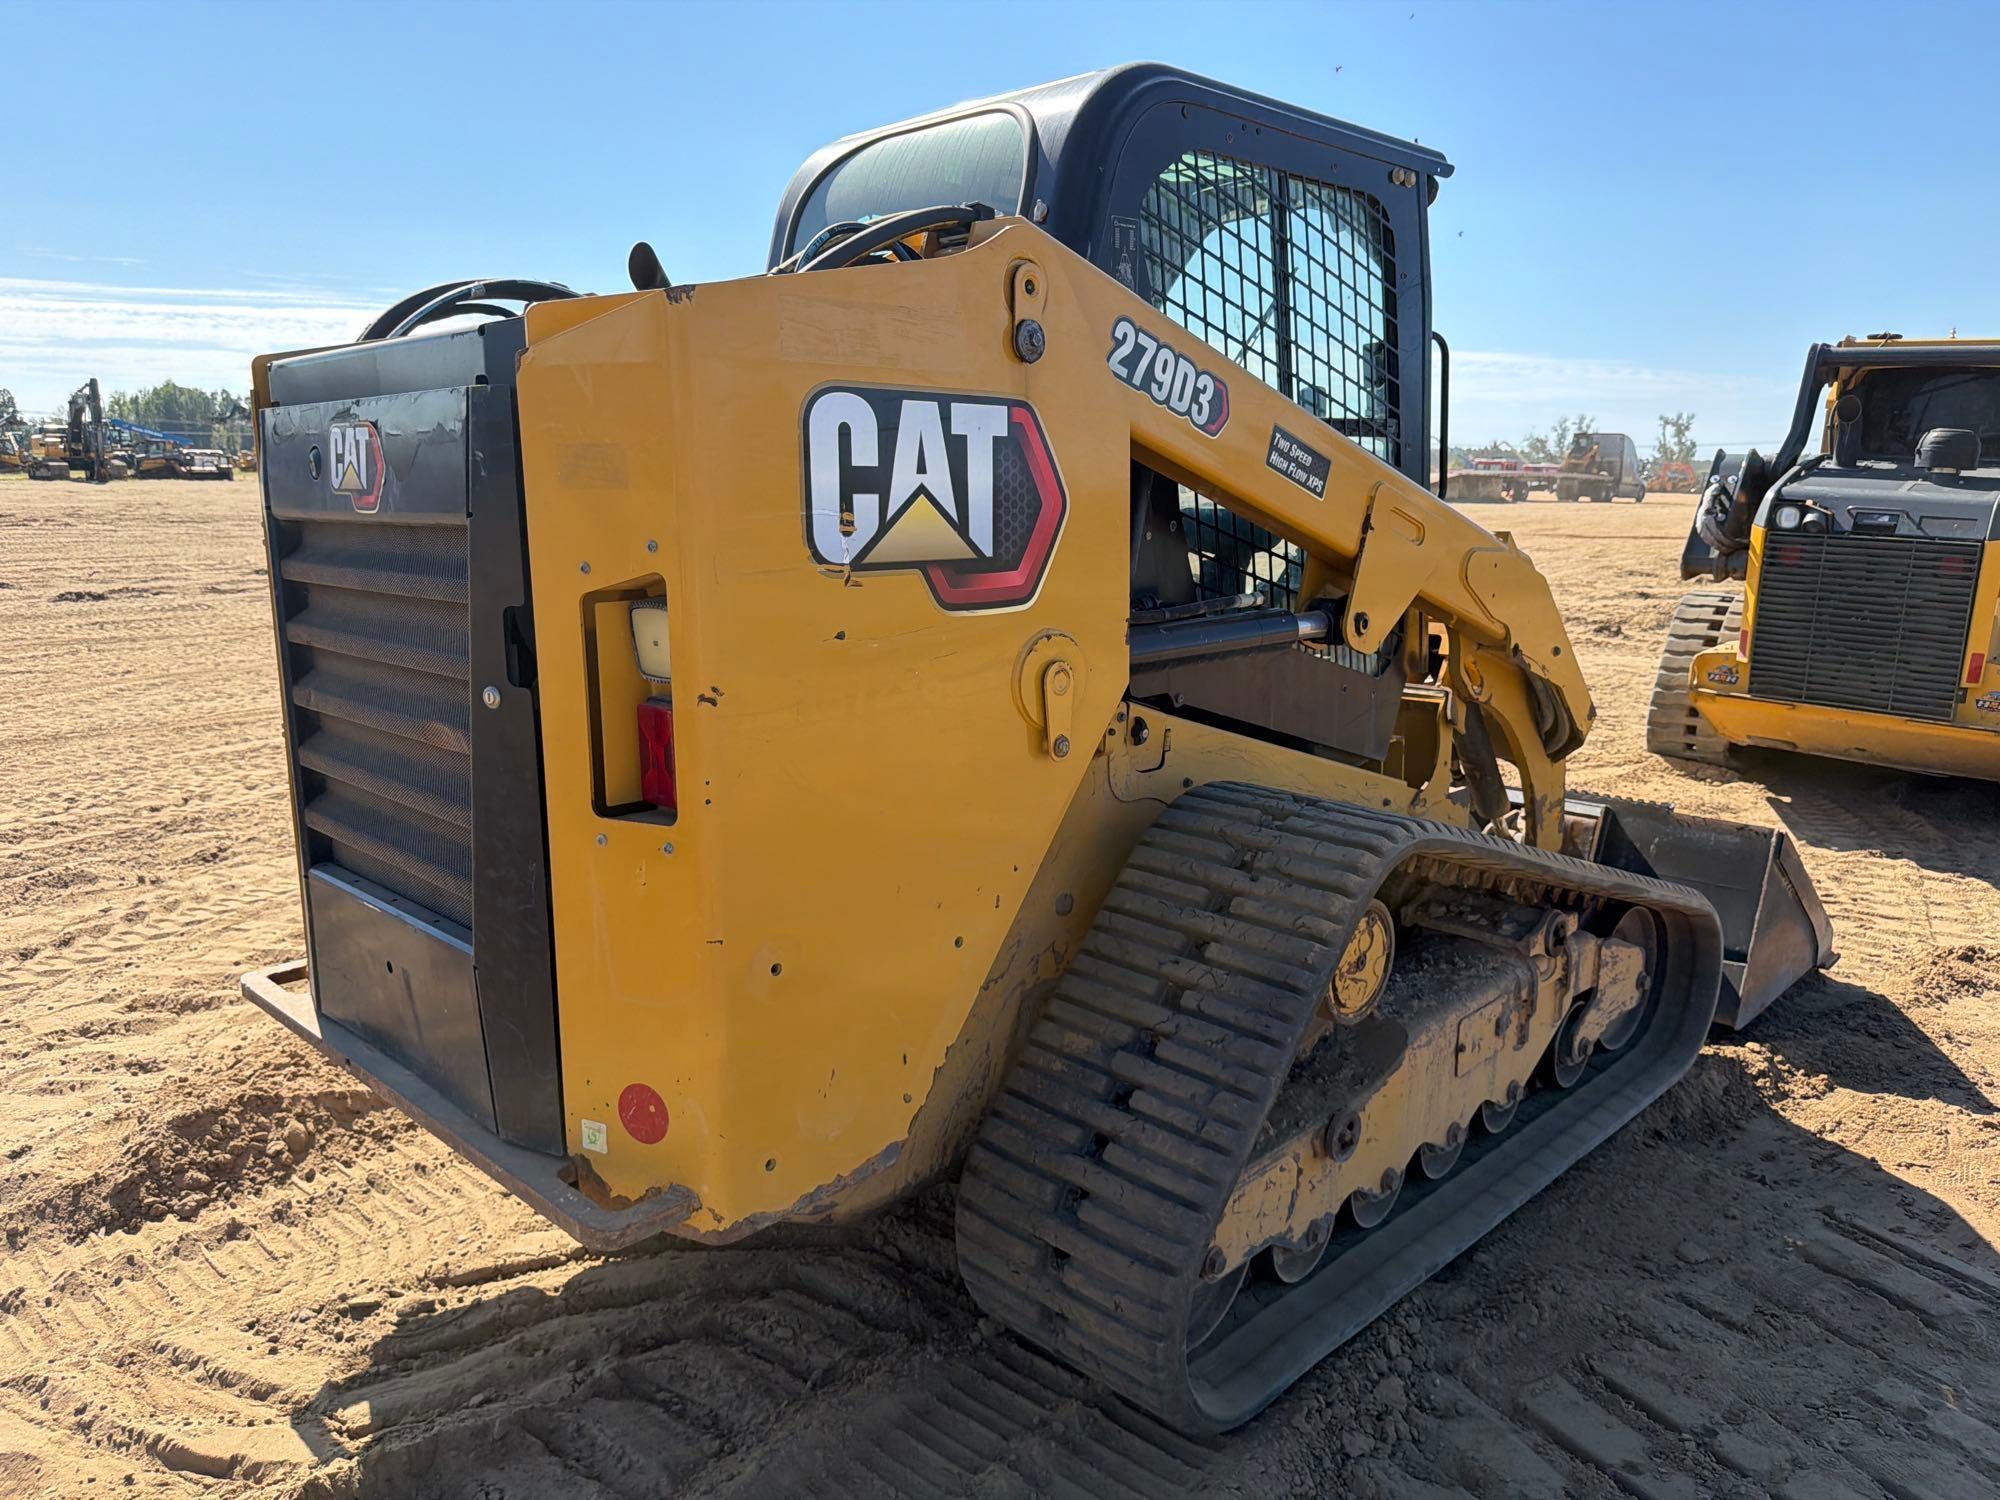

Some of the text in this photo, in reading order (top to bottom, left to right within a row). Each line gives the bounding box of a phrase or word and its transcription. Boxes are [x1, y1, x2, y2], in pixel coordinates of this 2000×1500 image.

[1108, 319, 1216, 426] 279D3
[329, 427, 370, 490] CAT
[809, 391, 1009, 565] CAT
[1269, 450, 1324, 493] HIGH FLOW XPS
[1273, 432, 1313, 467] TWO SPEED
